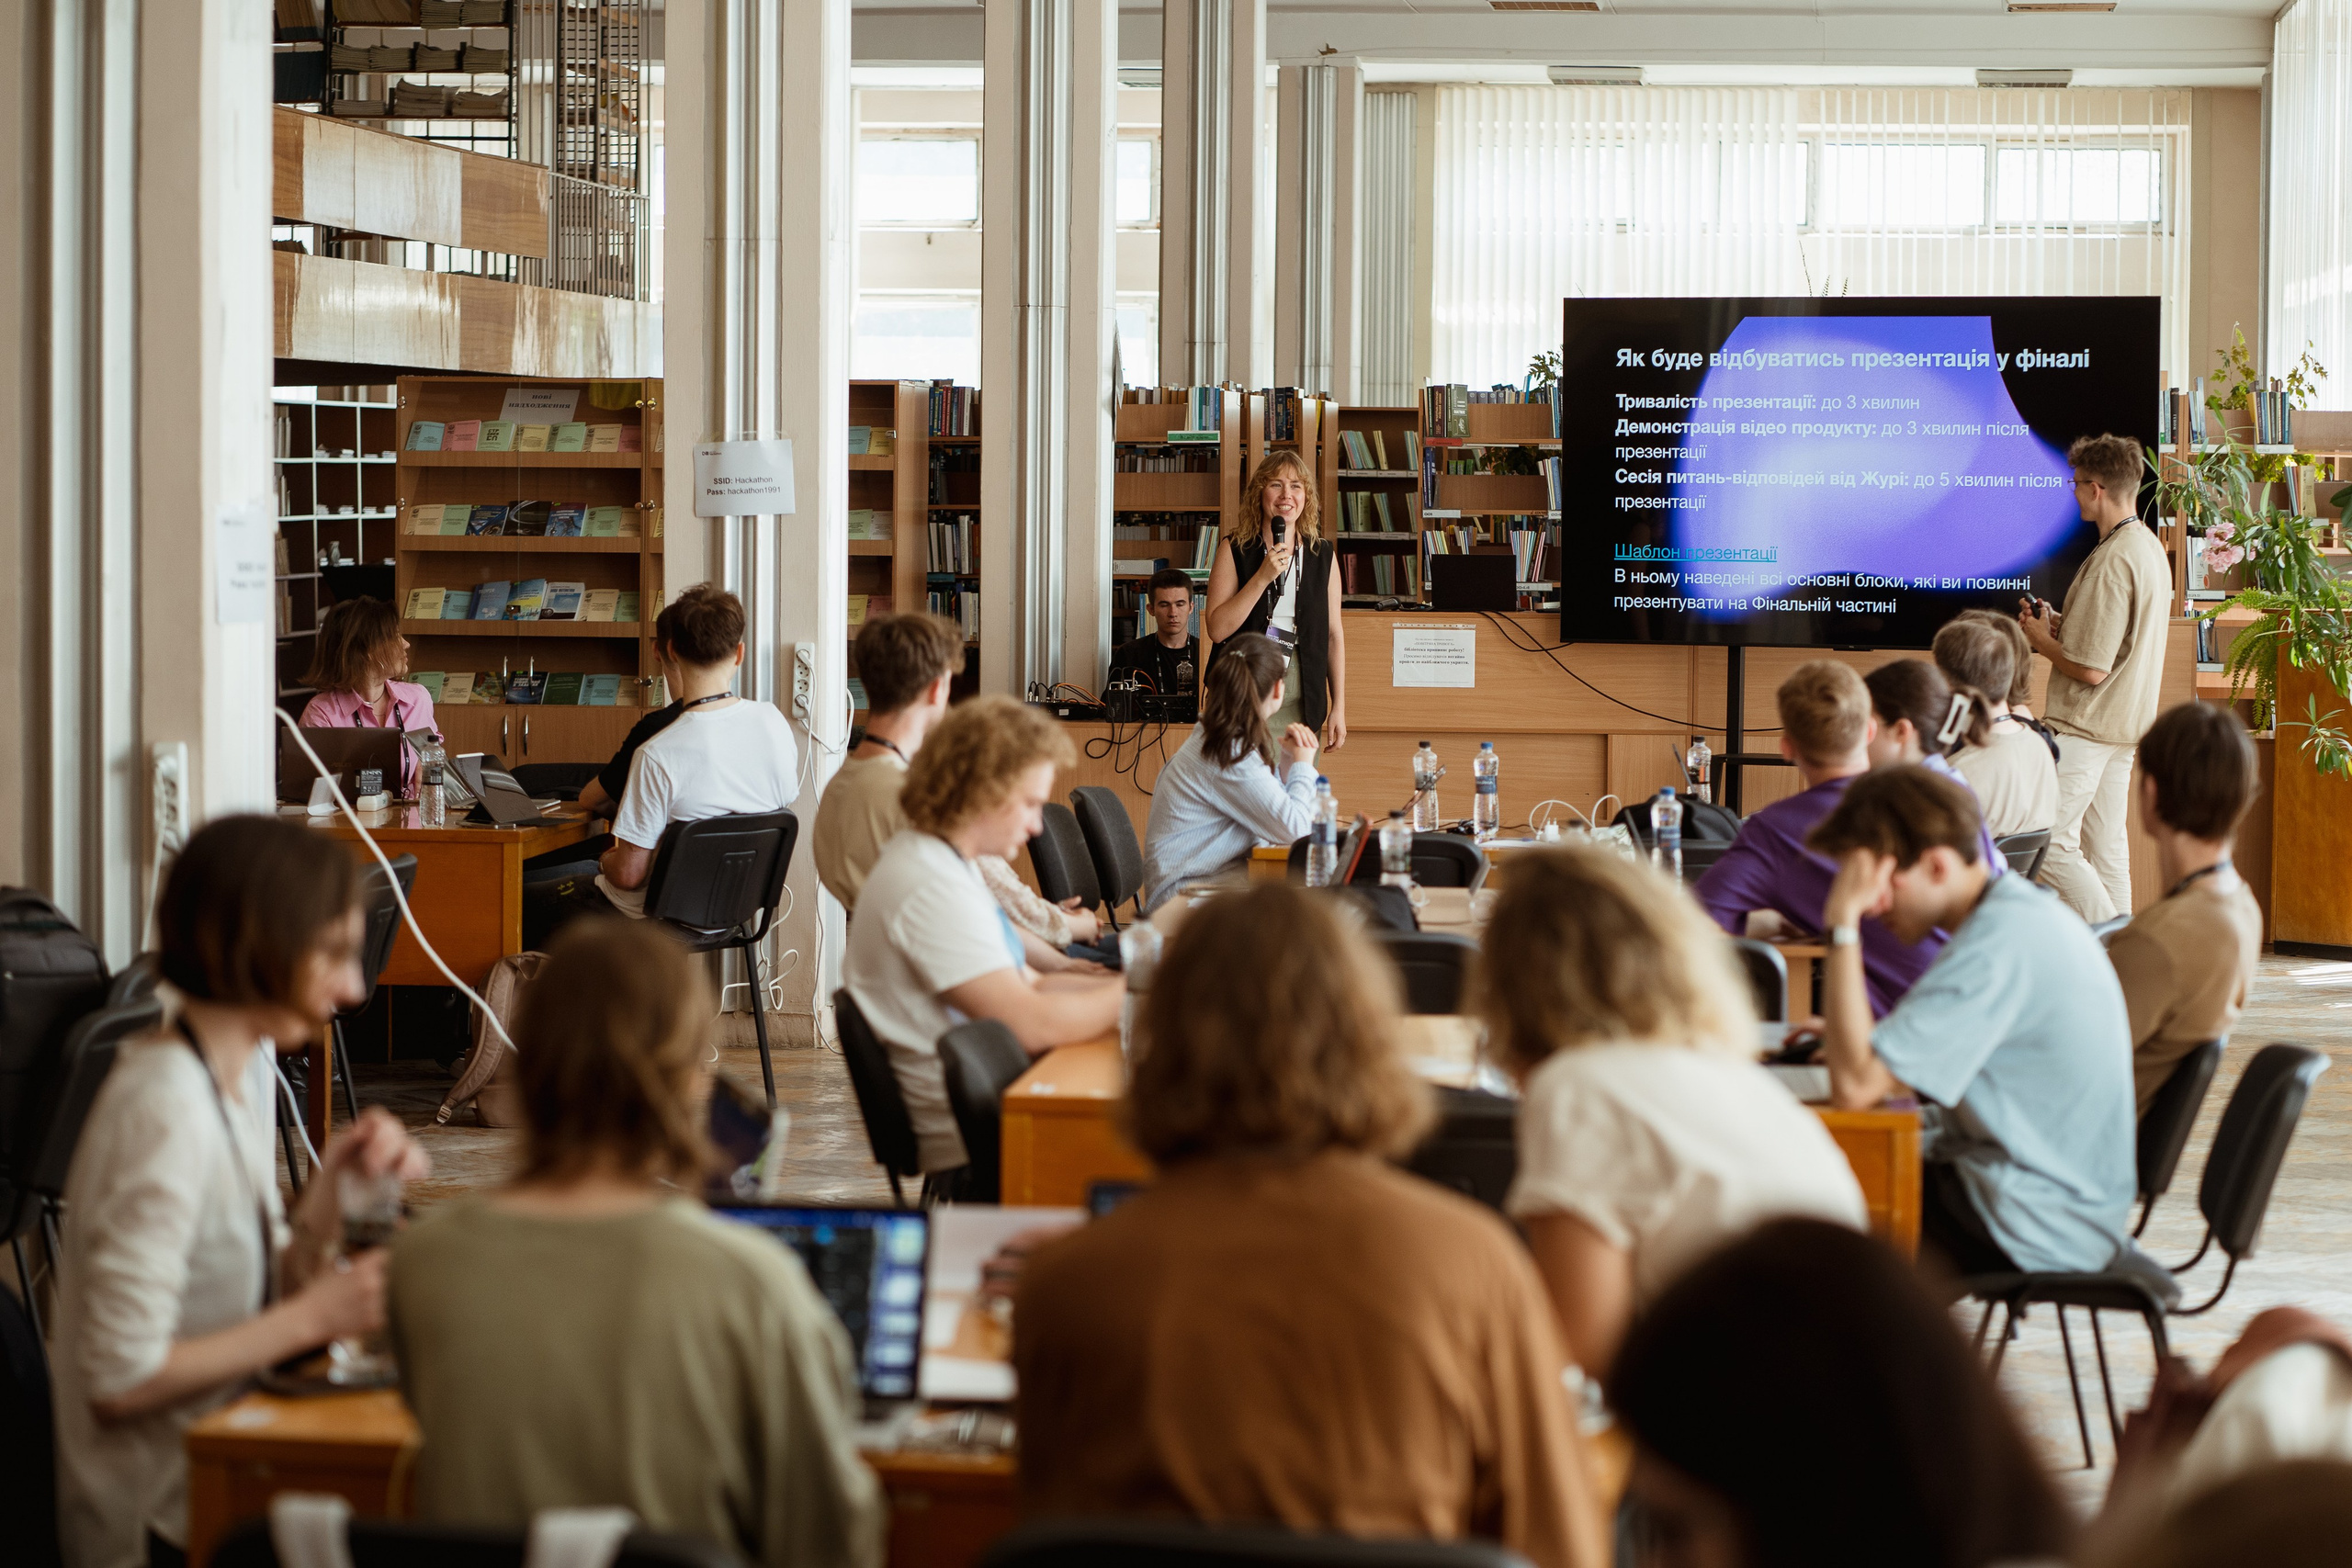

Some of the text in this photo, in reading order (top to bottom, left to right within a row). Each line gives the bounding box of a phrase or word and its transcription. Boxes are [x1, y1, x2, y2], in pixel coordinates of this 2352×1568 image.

[1616, 348, 2090, 372] Як буде відбуватись презентація у фіналі
[1616, 393, 1920, 412] Тривалість презентації: до 3 хвилин
[1615, 418, 2030, 437] Демонстрація відео продукту: до 3 хвилин після
[1615, 445, 1707, 462] презентації
[1615, 468, 2063, 489] Сесія питань-відповідей від Журі: до 5 хвилин після
[727, 487, 781, 495] hackathon1991
[1615, 495, 1707, 512] презентації
[1614, 544, 1779, 562] Шаблон презентації
[1614, 568, 2030, 591] В ньому наведені всі основні блоки, які ви повинні
[1614, 595, 1896, 613] презентувати на Фінальній частині
